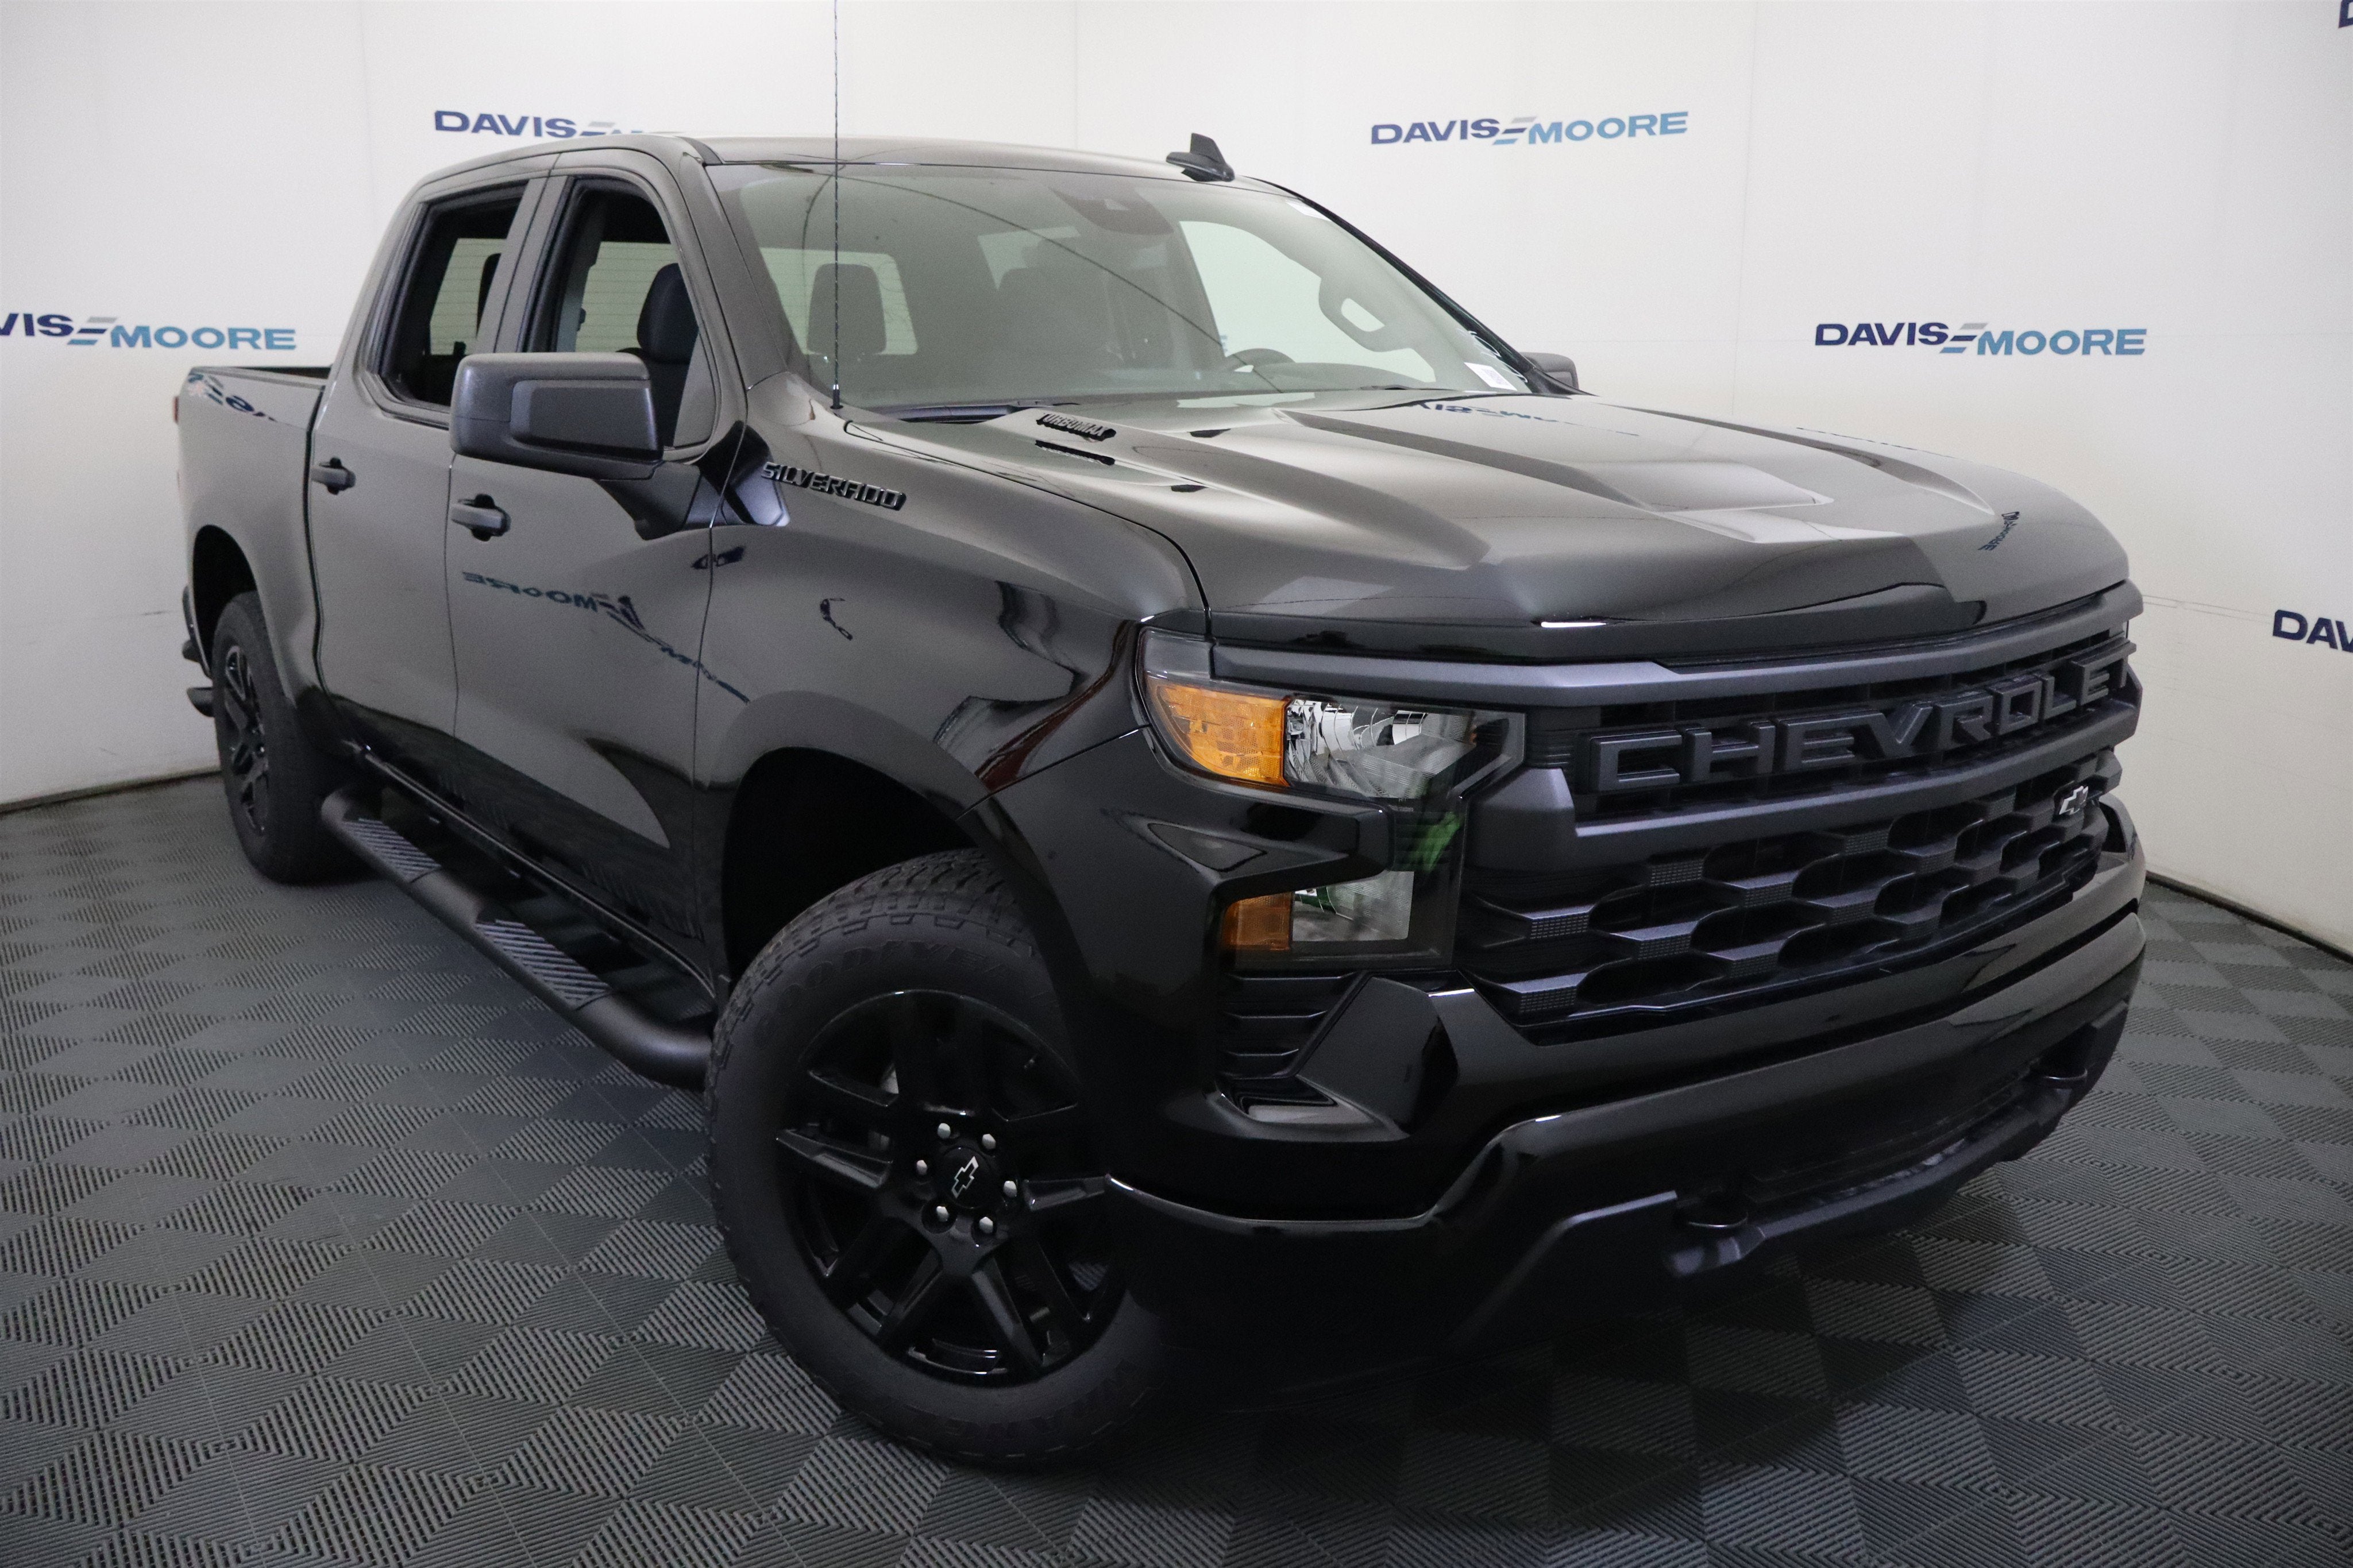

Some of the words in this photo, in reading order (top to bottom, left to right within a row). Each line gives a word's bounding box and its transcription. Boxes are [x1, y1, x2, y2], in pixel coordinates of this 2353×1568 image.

[435, 110, 577, 138] DAVIS
[1371, 118, 1500, 145] DAVIS
[1528, 111, 1689, 145] MOORE
[110, 325, 297, 350] MOORE
[1815, 322, 1949, 346] DAVIS
[1977, 329, 2147, 356] MOORE
[761, 461, 907, 511] SILVERADO
[1590, 639, 2136, 792] CHEVROLET
